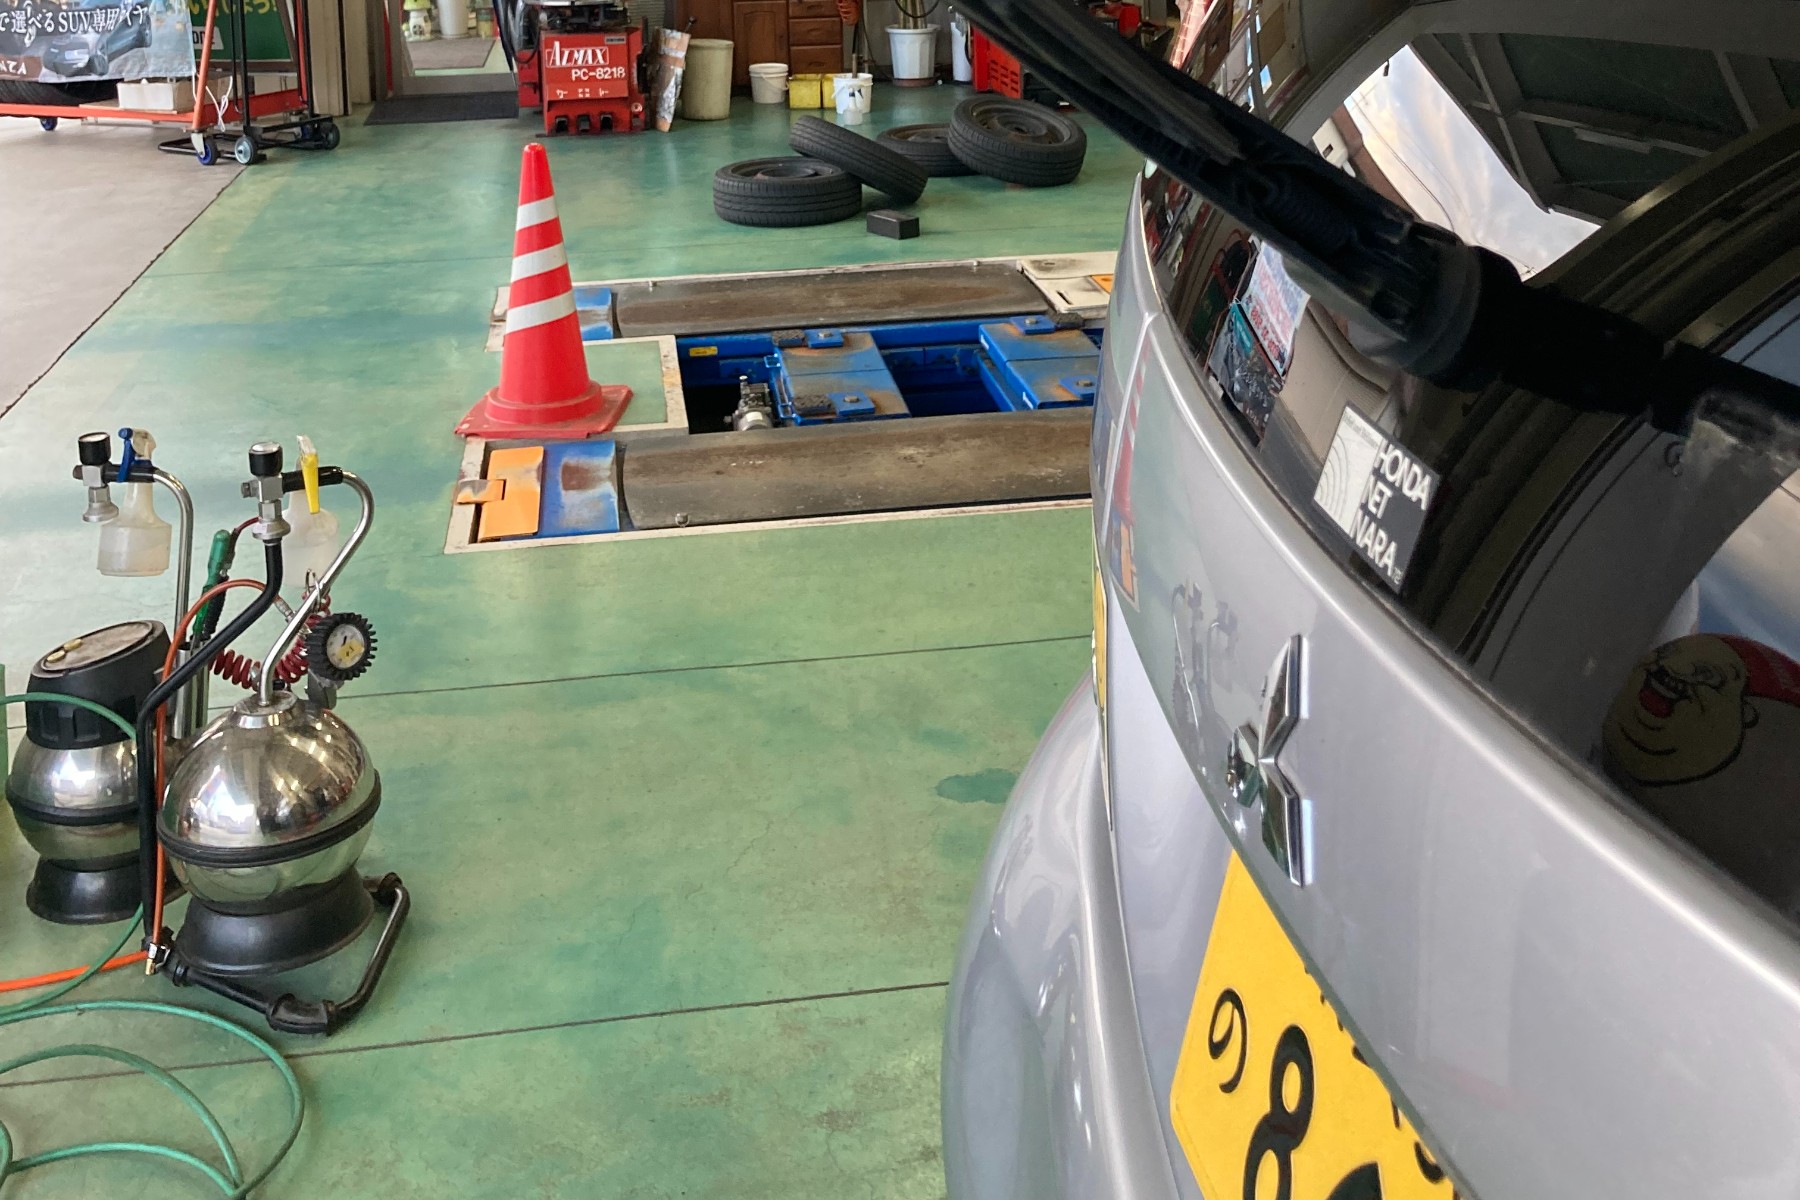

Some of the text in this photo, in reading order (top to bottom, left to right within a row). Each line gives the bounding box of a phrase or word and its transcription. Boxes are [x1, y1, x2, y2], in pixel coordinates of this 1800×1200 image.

[1361, 475, 1392, 519] NET
[1374, 439, 1432, 511] HONDA
[1350, 509, 1398, 575] NARA
